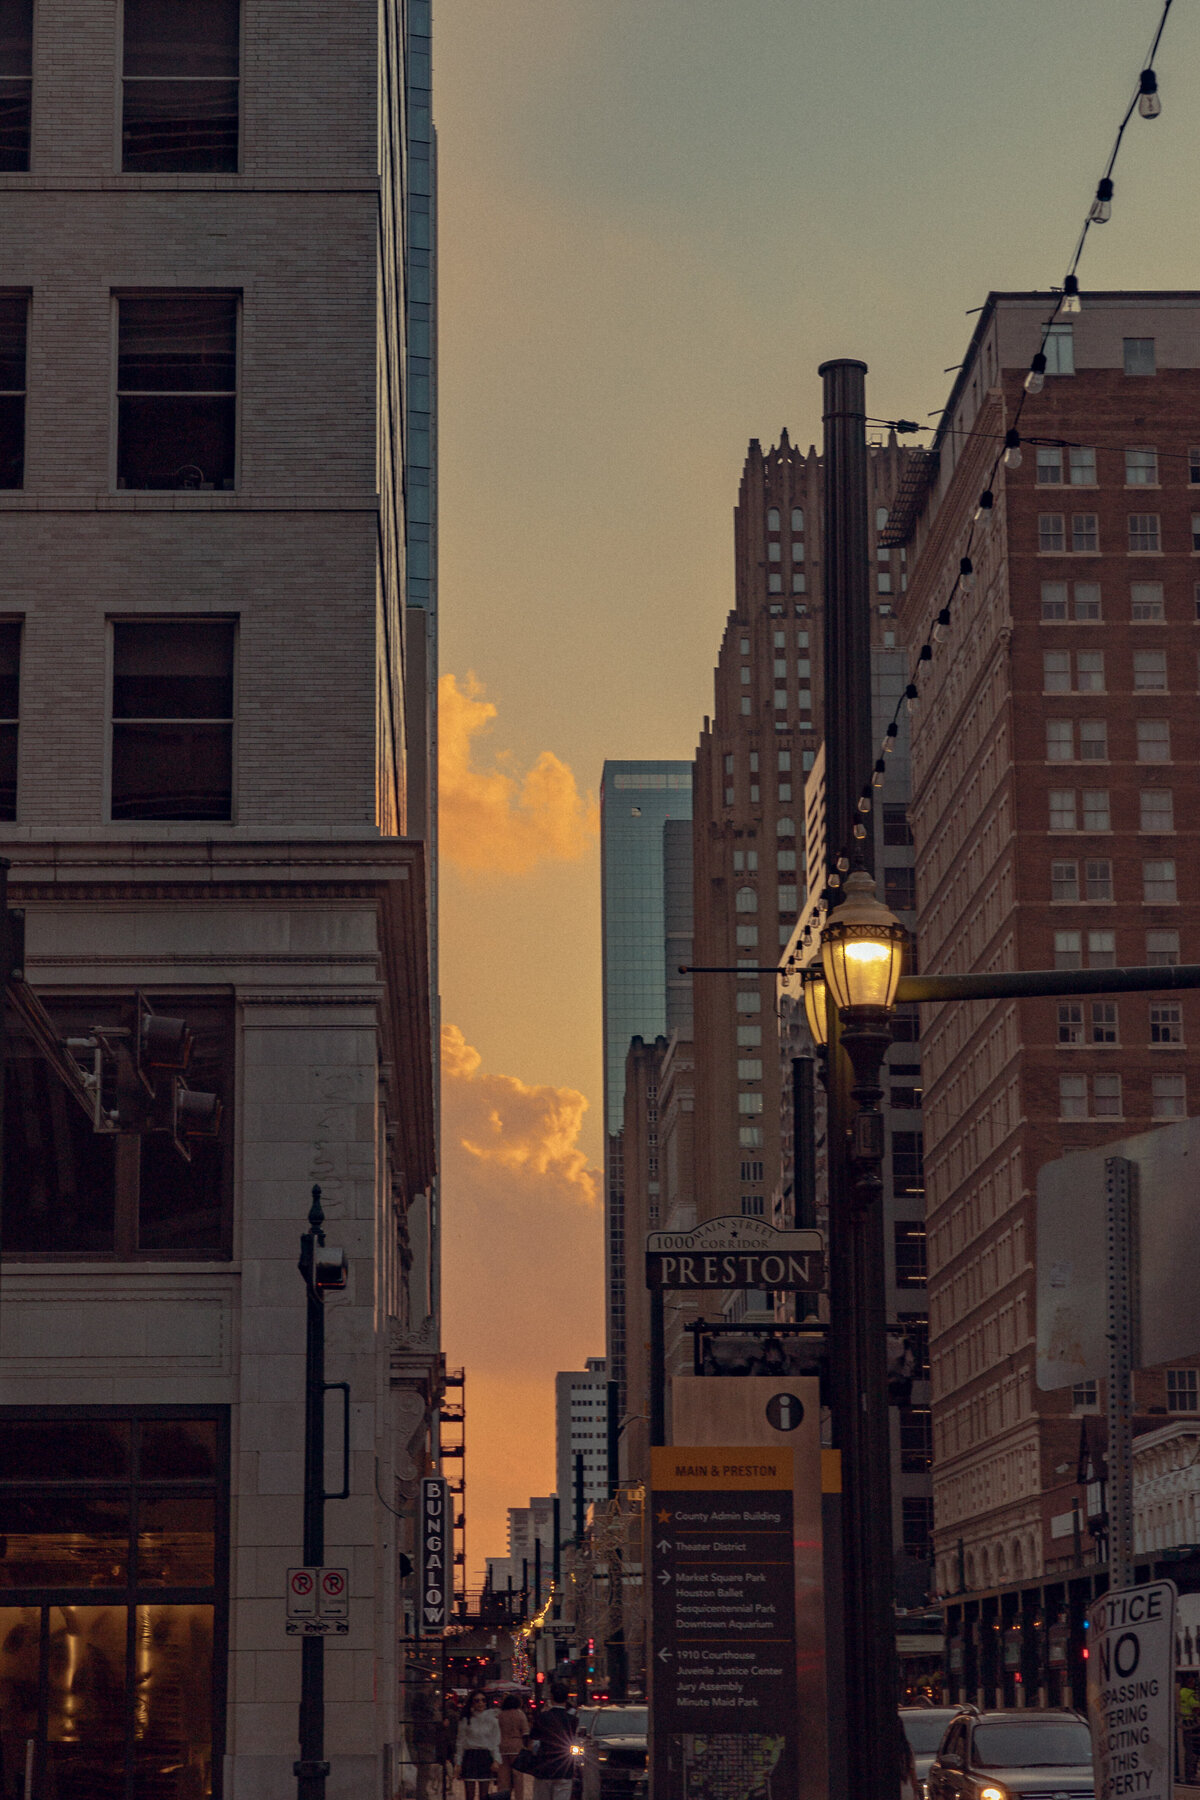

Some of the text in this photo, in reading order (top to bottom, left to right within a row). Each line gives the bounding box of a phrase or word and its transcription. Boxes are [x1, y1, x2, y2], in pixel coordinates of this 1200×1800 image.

[694, 1219, 776, 1241] MAIN STREET
[657, 1236, 769, 1249] 1000 CORRIDOR
[659, 1255, 810, 1284] PRESTON
[675, 1465, 777, 1477] MAIN & PRESTON
[675, 1511, 782, 1523] County Admin Building
[676, 1542, 747, 1551] Theater District
[424, 1482, 445, 1623] BUNGALOW
[675, 1573, 767, 1583] Market Square Park
[675, 1588, 744, 1598] Houston Ballet
[675, 1604, 776, 1615] Sesquicentennial Park
[1092, 1590, 1163, 1636] NOTICE
[676, 1620, 774, 1630] Downtown Aquarium
[677, 1650, 756, 1660] 1910 Courthouse
[1099, 1631, 1141, 1687] NO
[676, 1666, 783, 1676] Juvenile Justice Center
[677, 1682, 744, 1693] Jury Assembly
[677, 1698, 760, 1707] Minute Maid Park
[1111, 1751, 1139, 1774] THIS
